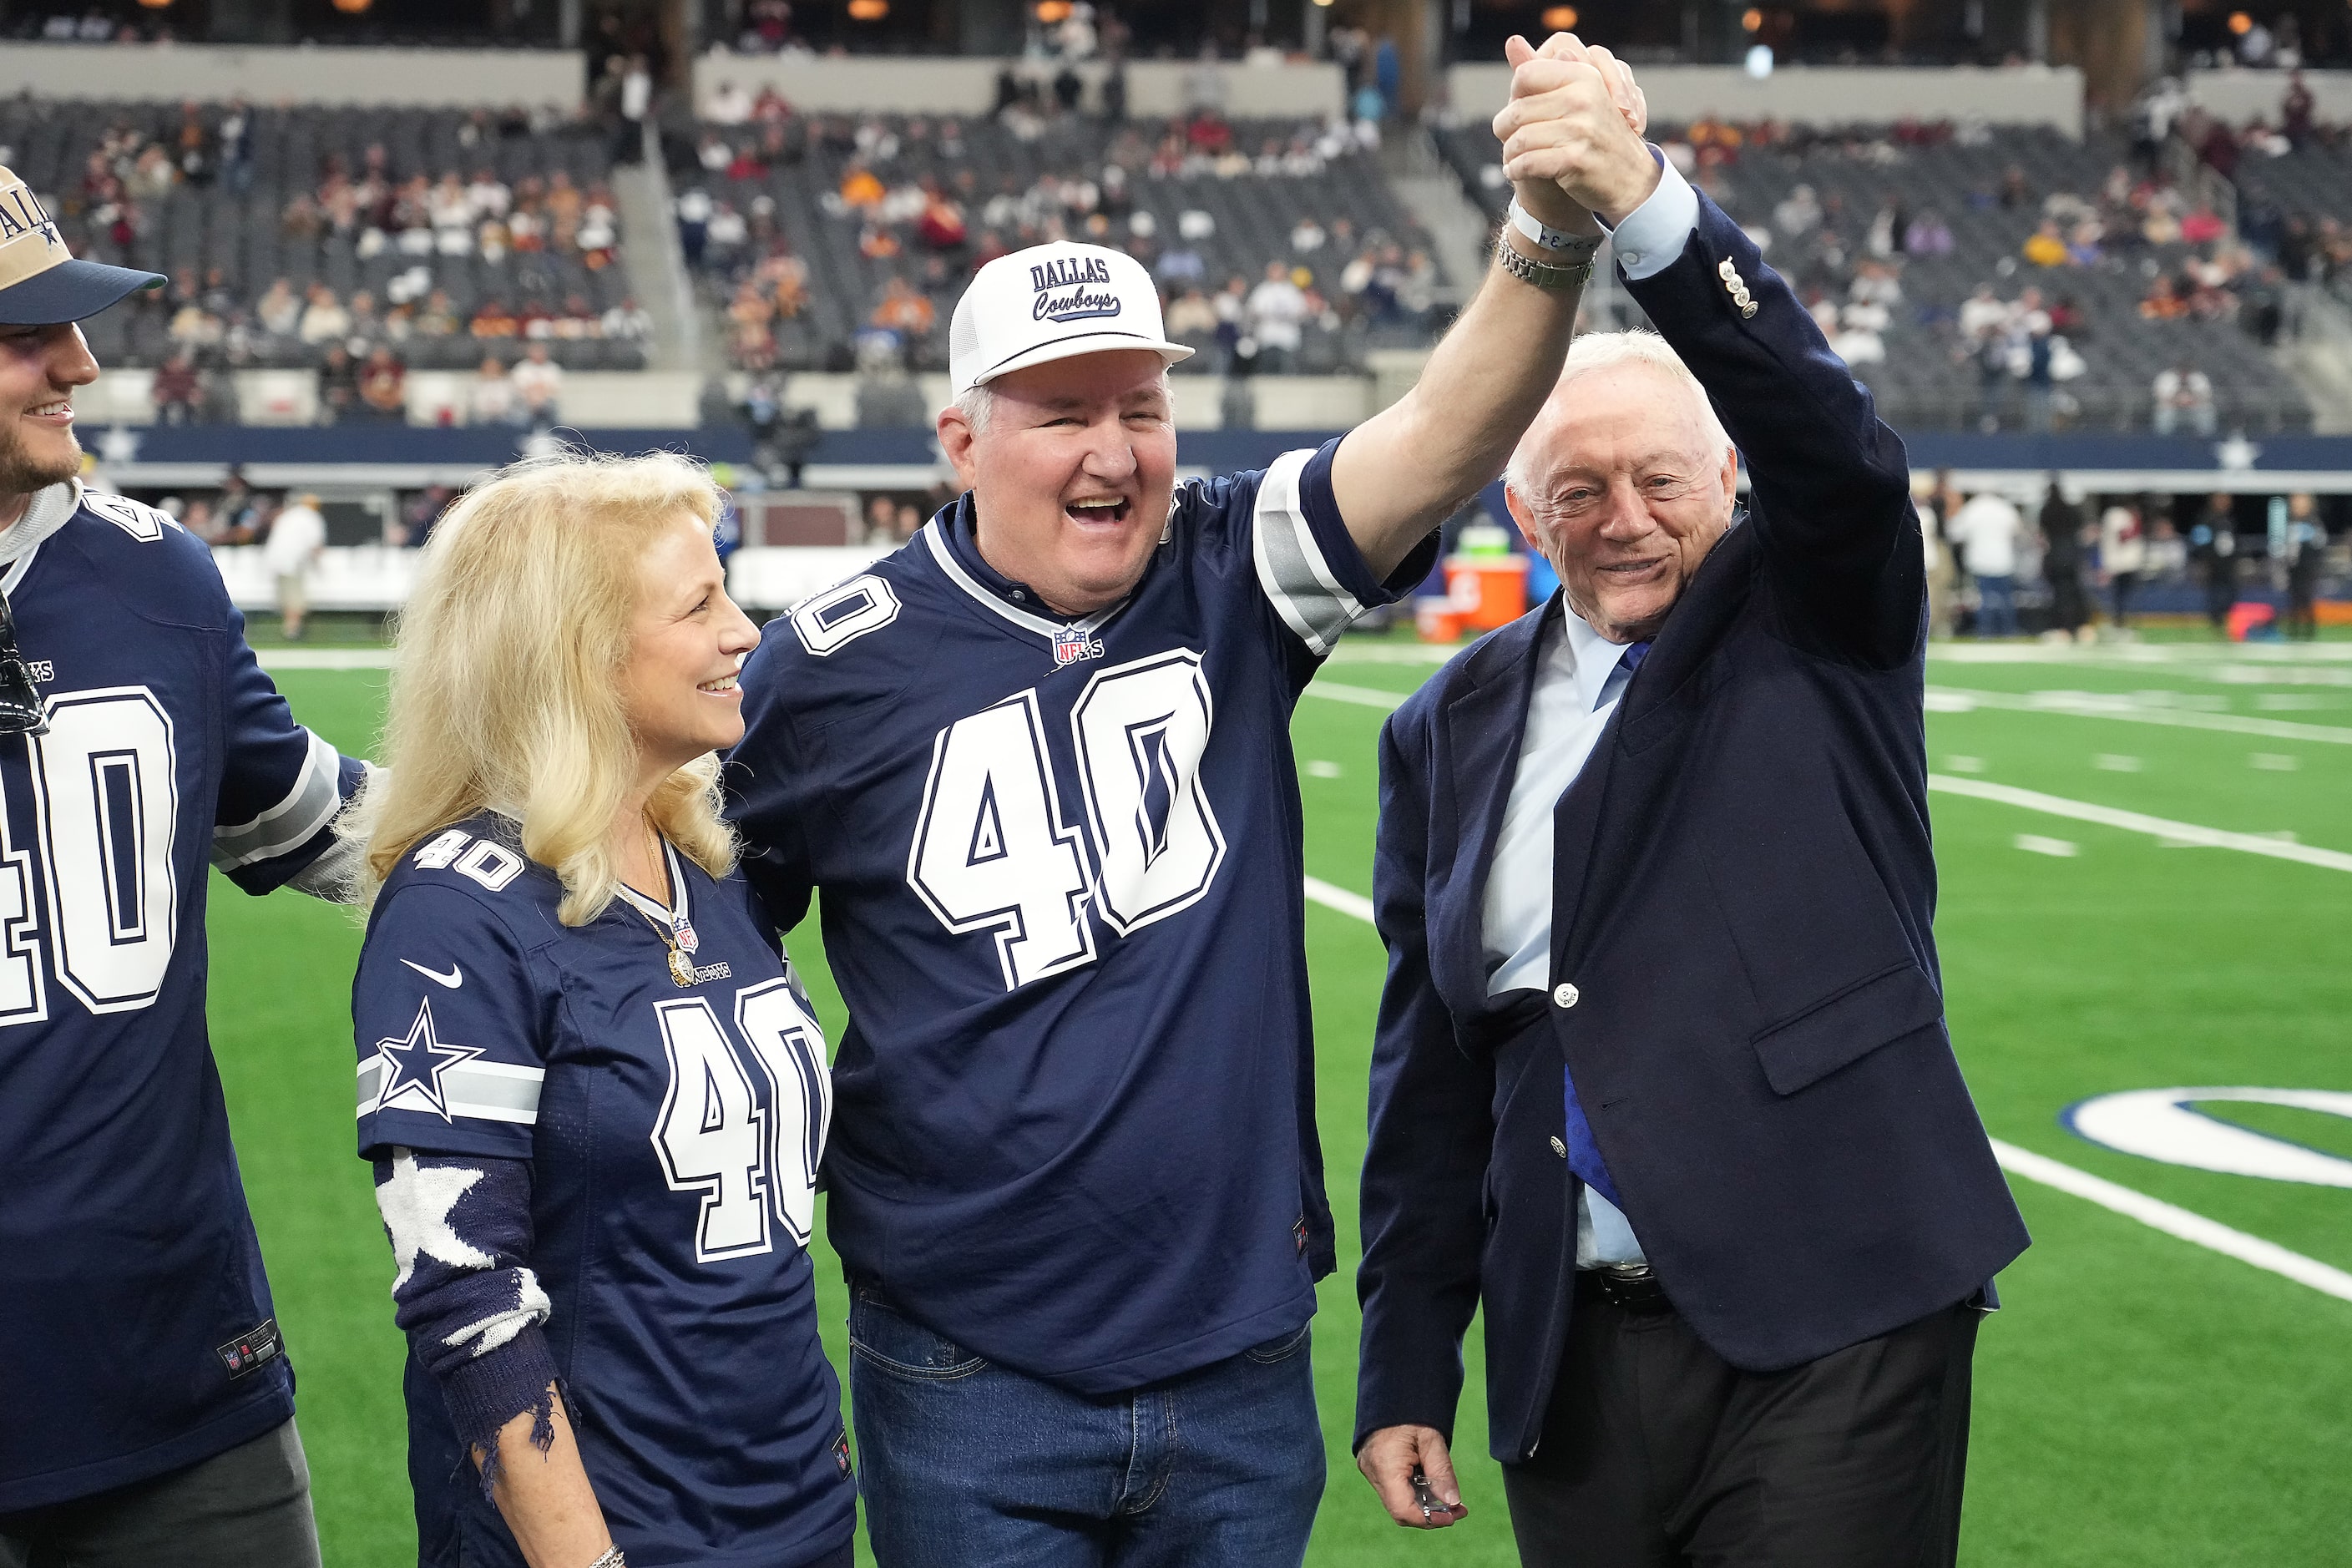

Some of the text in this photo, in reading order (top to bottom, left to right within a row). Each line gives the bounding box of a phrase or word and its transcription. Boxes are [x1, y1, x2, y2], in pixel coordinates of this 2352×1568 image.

[1029, 257, 1110, 293] DALLAS
[1032, 285, 1121, 322] Cowboys
[81, 487, 185, 544] 4
[782, 564, 903, 657] 0
[906, 646, 1228, 993] 40
[0, 683, 179, 1028] 0
[412, 828, 526, 893] 40
[677, 928, 696, 947] NFL
[670, 961, 732, 989] WBOYS
[649, 975, 833, 1264] 40
